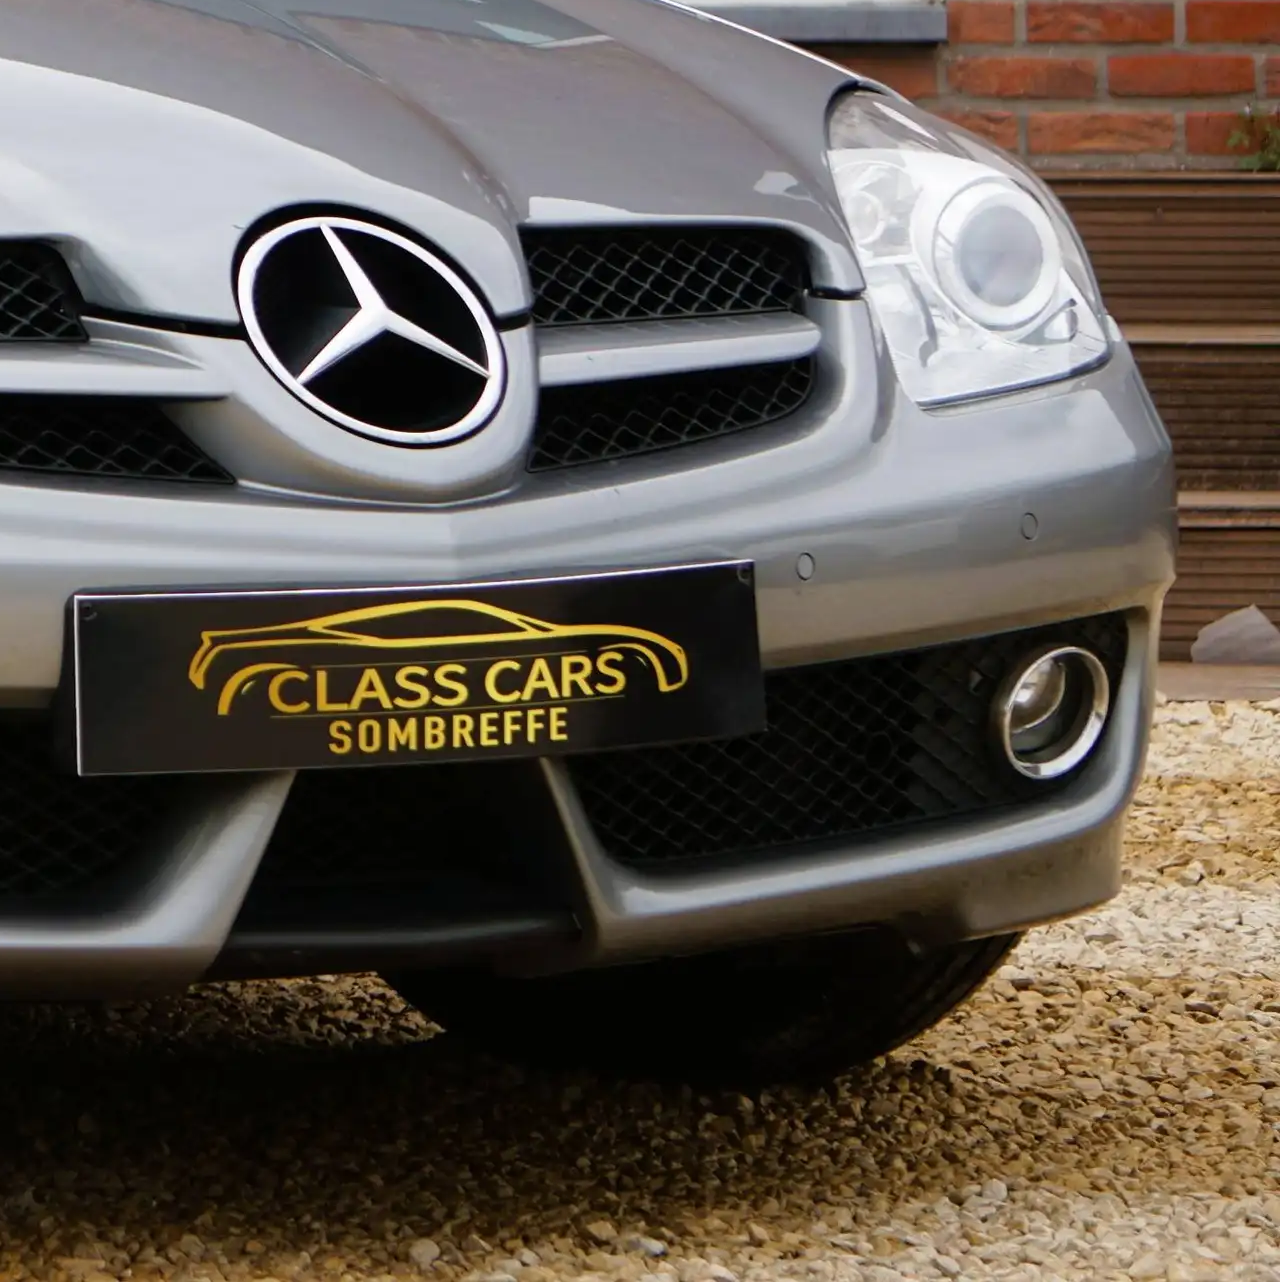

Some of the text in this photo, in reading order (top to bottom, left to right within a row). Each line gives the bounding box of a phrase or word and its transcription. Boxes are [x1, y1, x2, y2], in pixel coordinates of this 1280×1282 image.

[268, 651, 626, 714] CLASS CARS
[328, 706, 568, 755] SOMBREFFE
